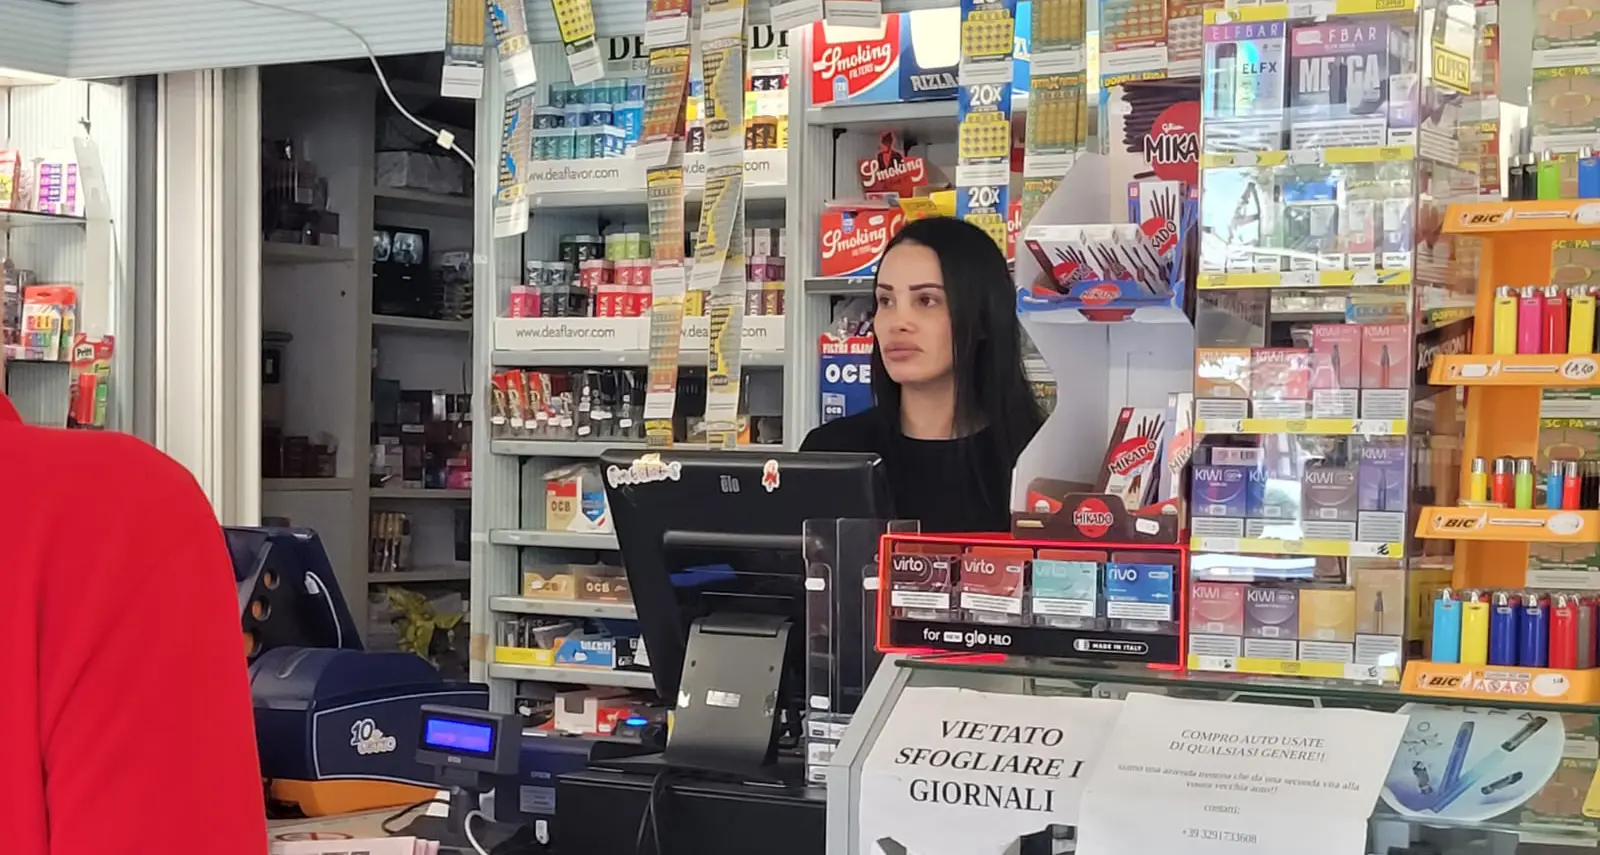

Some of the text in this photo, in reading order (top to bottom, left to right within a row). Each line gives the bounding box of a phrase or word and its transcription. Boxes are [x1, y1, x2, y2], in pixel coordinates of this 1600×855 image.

[1211, 24, 1278, 41] ELFBAR
[821, 43, 892, 80] Smoking
[1243, 63, 1277, 75] ELFX
[911, 73, 958, 91] RIZLA
[970, 84, 1002, 107] 20X
[1143, 132, 1200, 165] MIKA
[529, 164, 619, 181] ww.deaflavor.com
[861, 158, 925, 188] Smoking
[967, 186, 1000, 208] 20X
[1470, 214, 1502, 224] BIC
[822, 222, 890, 259] Smoking
[516, 322, 616, 339] www.deaflavor.com
[1108, 440, 1158, 475] MIKADO
[1195, 469, 1223, 481] KIWI
[1304, 471, 1334, 484] KIWI
[550, 500, 572, 513] OCB
[1072, 510, 1114, 526] MIKADO
[1444, 518, 1477, 529] BIC
[893, 556, 924, 571] virto
[964, 558, 995, 575] virto
[1108, 564, 1137, 581] rivo
[586, 581, 610, 592] OCB
[1192, 586, 1220, 599] KIWI
[1247, 589, 1276, 603] KIWI
[923, 628, 939, 641] for
[965, 629, 987, 648] glo
[989, 634, 1012, 646] HILO
[1092, 640, 1111, 650] MADE
[1114, 642, 1121, 650] IN
[1428, 676, 1461, 687] BIC
[941, 720, 1064, 747] VIETATO
[1181, 728, 1326, 749] COMPRO AUTO USATE
[1169, 740, 1326, 763] DI QUALSIASI GENERE!!
[895, 747, 1086, 779] SFOGLIARE I
[909, 779, 1056, 812] GIORNALI
[1182, 828, 1200, 838] +39
